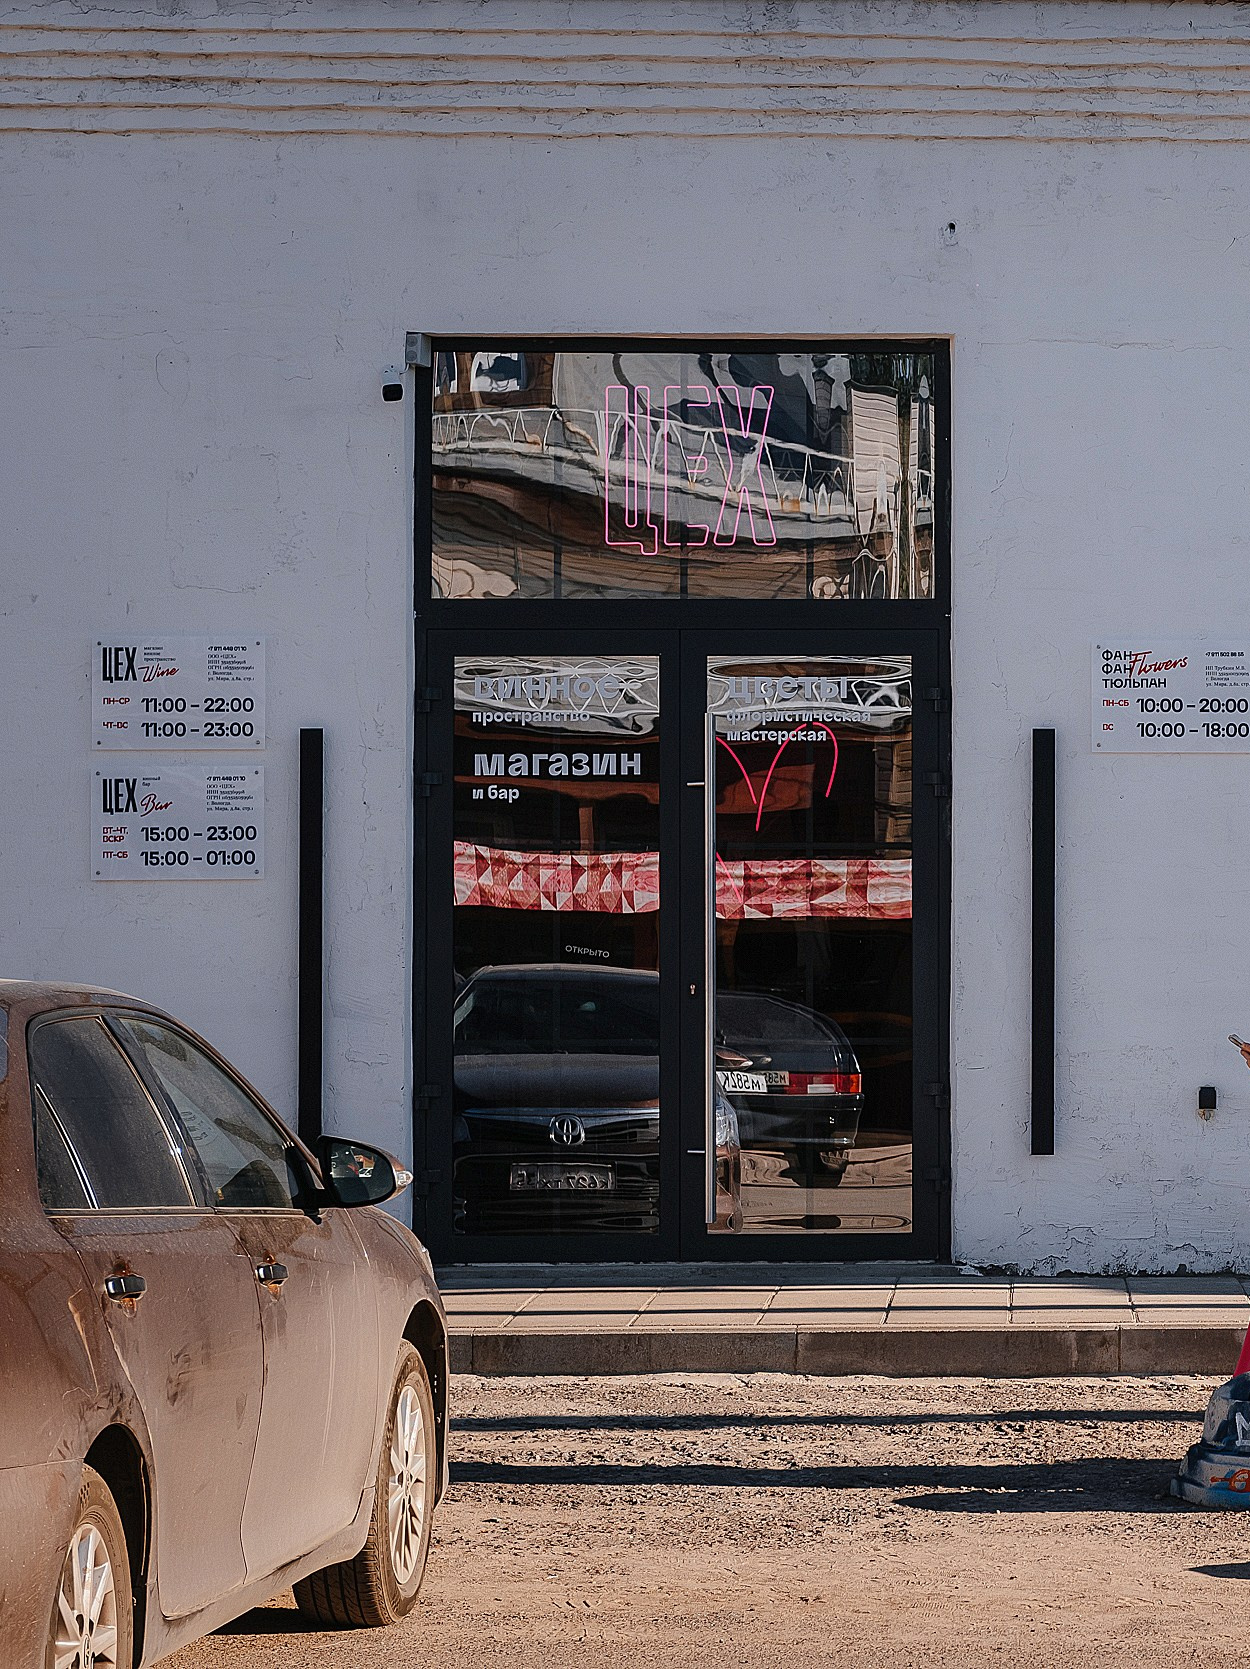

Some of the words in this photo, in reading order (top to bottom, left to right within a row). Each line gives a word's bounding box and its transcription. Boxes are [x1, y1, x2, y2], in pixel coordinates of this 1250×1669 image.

[604, 384, 777, 556] ЦЕХ
[1102, 649, 1132, 661] ФАН
[102, 647, 137, 683] ЦЕХ
[1102, 662, 1132, 675] ФАН
[1129, 651, 1188, 678] Flowers
[138, 663, 179, 682] Wine
[474, 677, 620, 699] винное
[728, 676, 848, 704] цветы
[1102, 678, 1167, 688] ТЮЛЬПАН
[141, 698, 186, 713] 11:00
[204, 698, 254, 713] 22:00
[1136, 698, 1183, 713] 10:00
[1199, 698, 1248, 713] 20:00
[472, 712, 590, 725] пространство
[727, 710, 871, 725] флористическая
[141, 722, 186, 737] 11:00
[204, 722, 253, 737] 23:00
[727, 730, 827, 744] мастерская
[1136, 722, 1185, 737] 10:00
[1202, 722, 1249, 737] 18:00
[474, 753, 641, 776] магазин
[102, 778, 137, 815] ЦЕХ
[472, 789, 484, 799] и
[487, 785, 520, 803] бар
[140, 793, 173, 817] Bar
[141, 827, 189, 841] 15:00
[207, 826, 257, 841] 23:00
[140, 851, 189, 866] 15:00
[207, 851, 255, 865] 01:00
[565, 945, 609, 958] ОТКРЫТО
